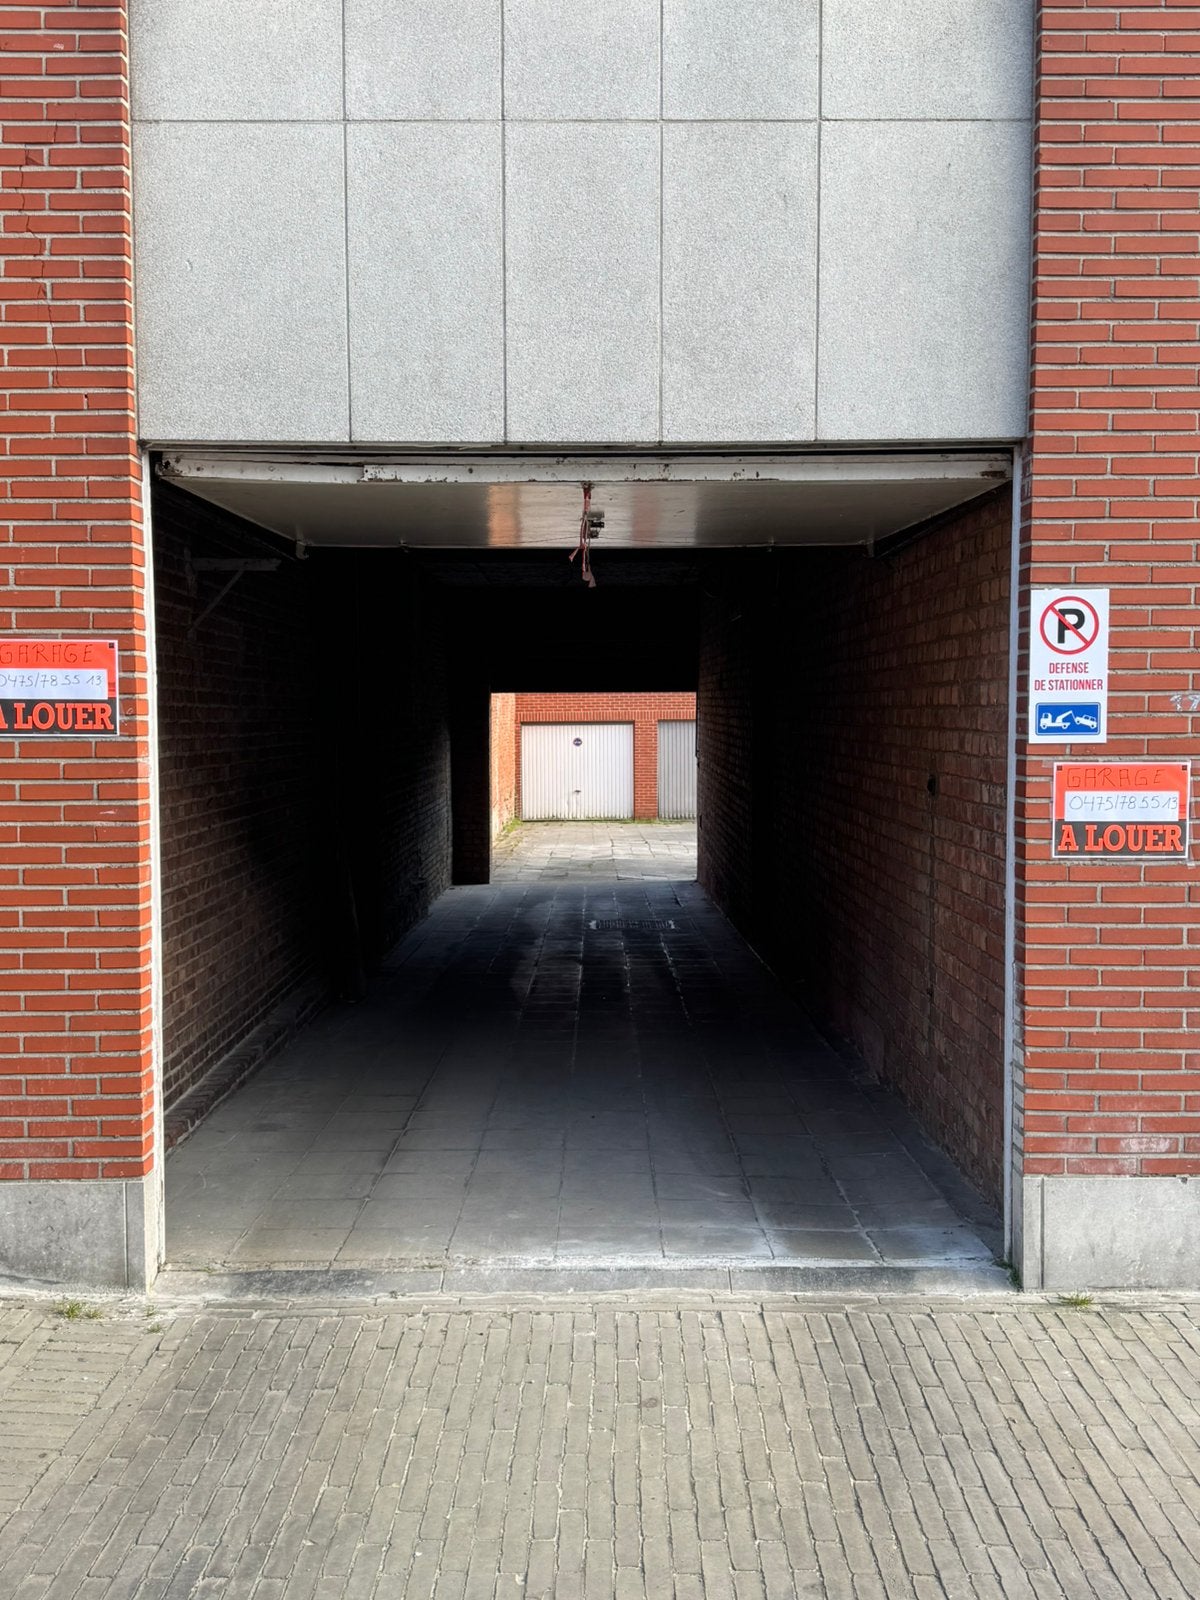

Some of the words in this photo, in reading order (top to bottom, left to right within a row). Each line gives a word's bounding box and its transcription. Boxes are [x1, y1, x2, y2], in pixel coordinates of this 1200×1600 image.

[0, 643, 93, 664] GARAGE
[1048, 662, 1089, 674] DEFENSE
[1034, 680, 1046, 691] DE
[1048, 679, 1103, 691] STATIONNER
[14, 702, 114, 730] LOUER
[1066, 767, 1165, 788] GARAGE
[1058, 825, 1079, 852] A
[1085, 824, 1183, 852] LOUER
